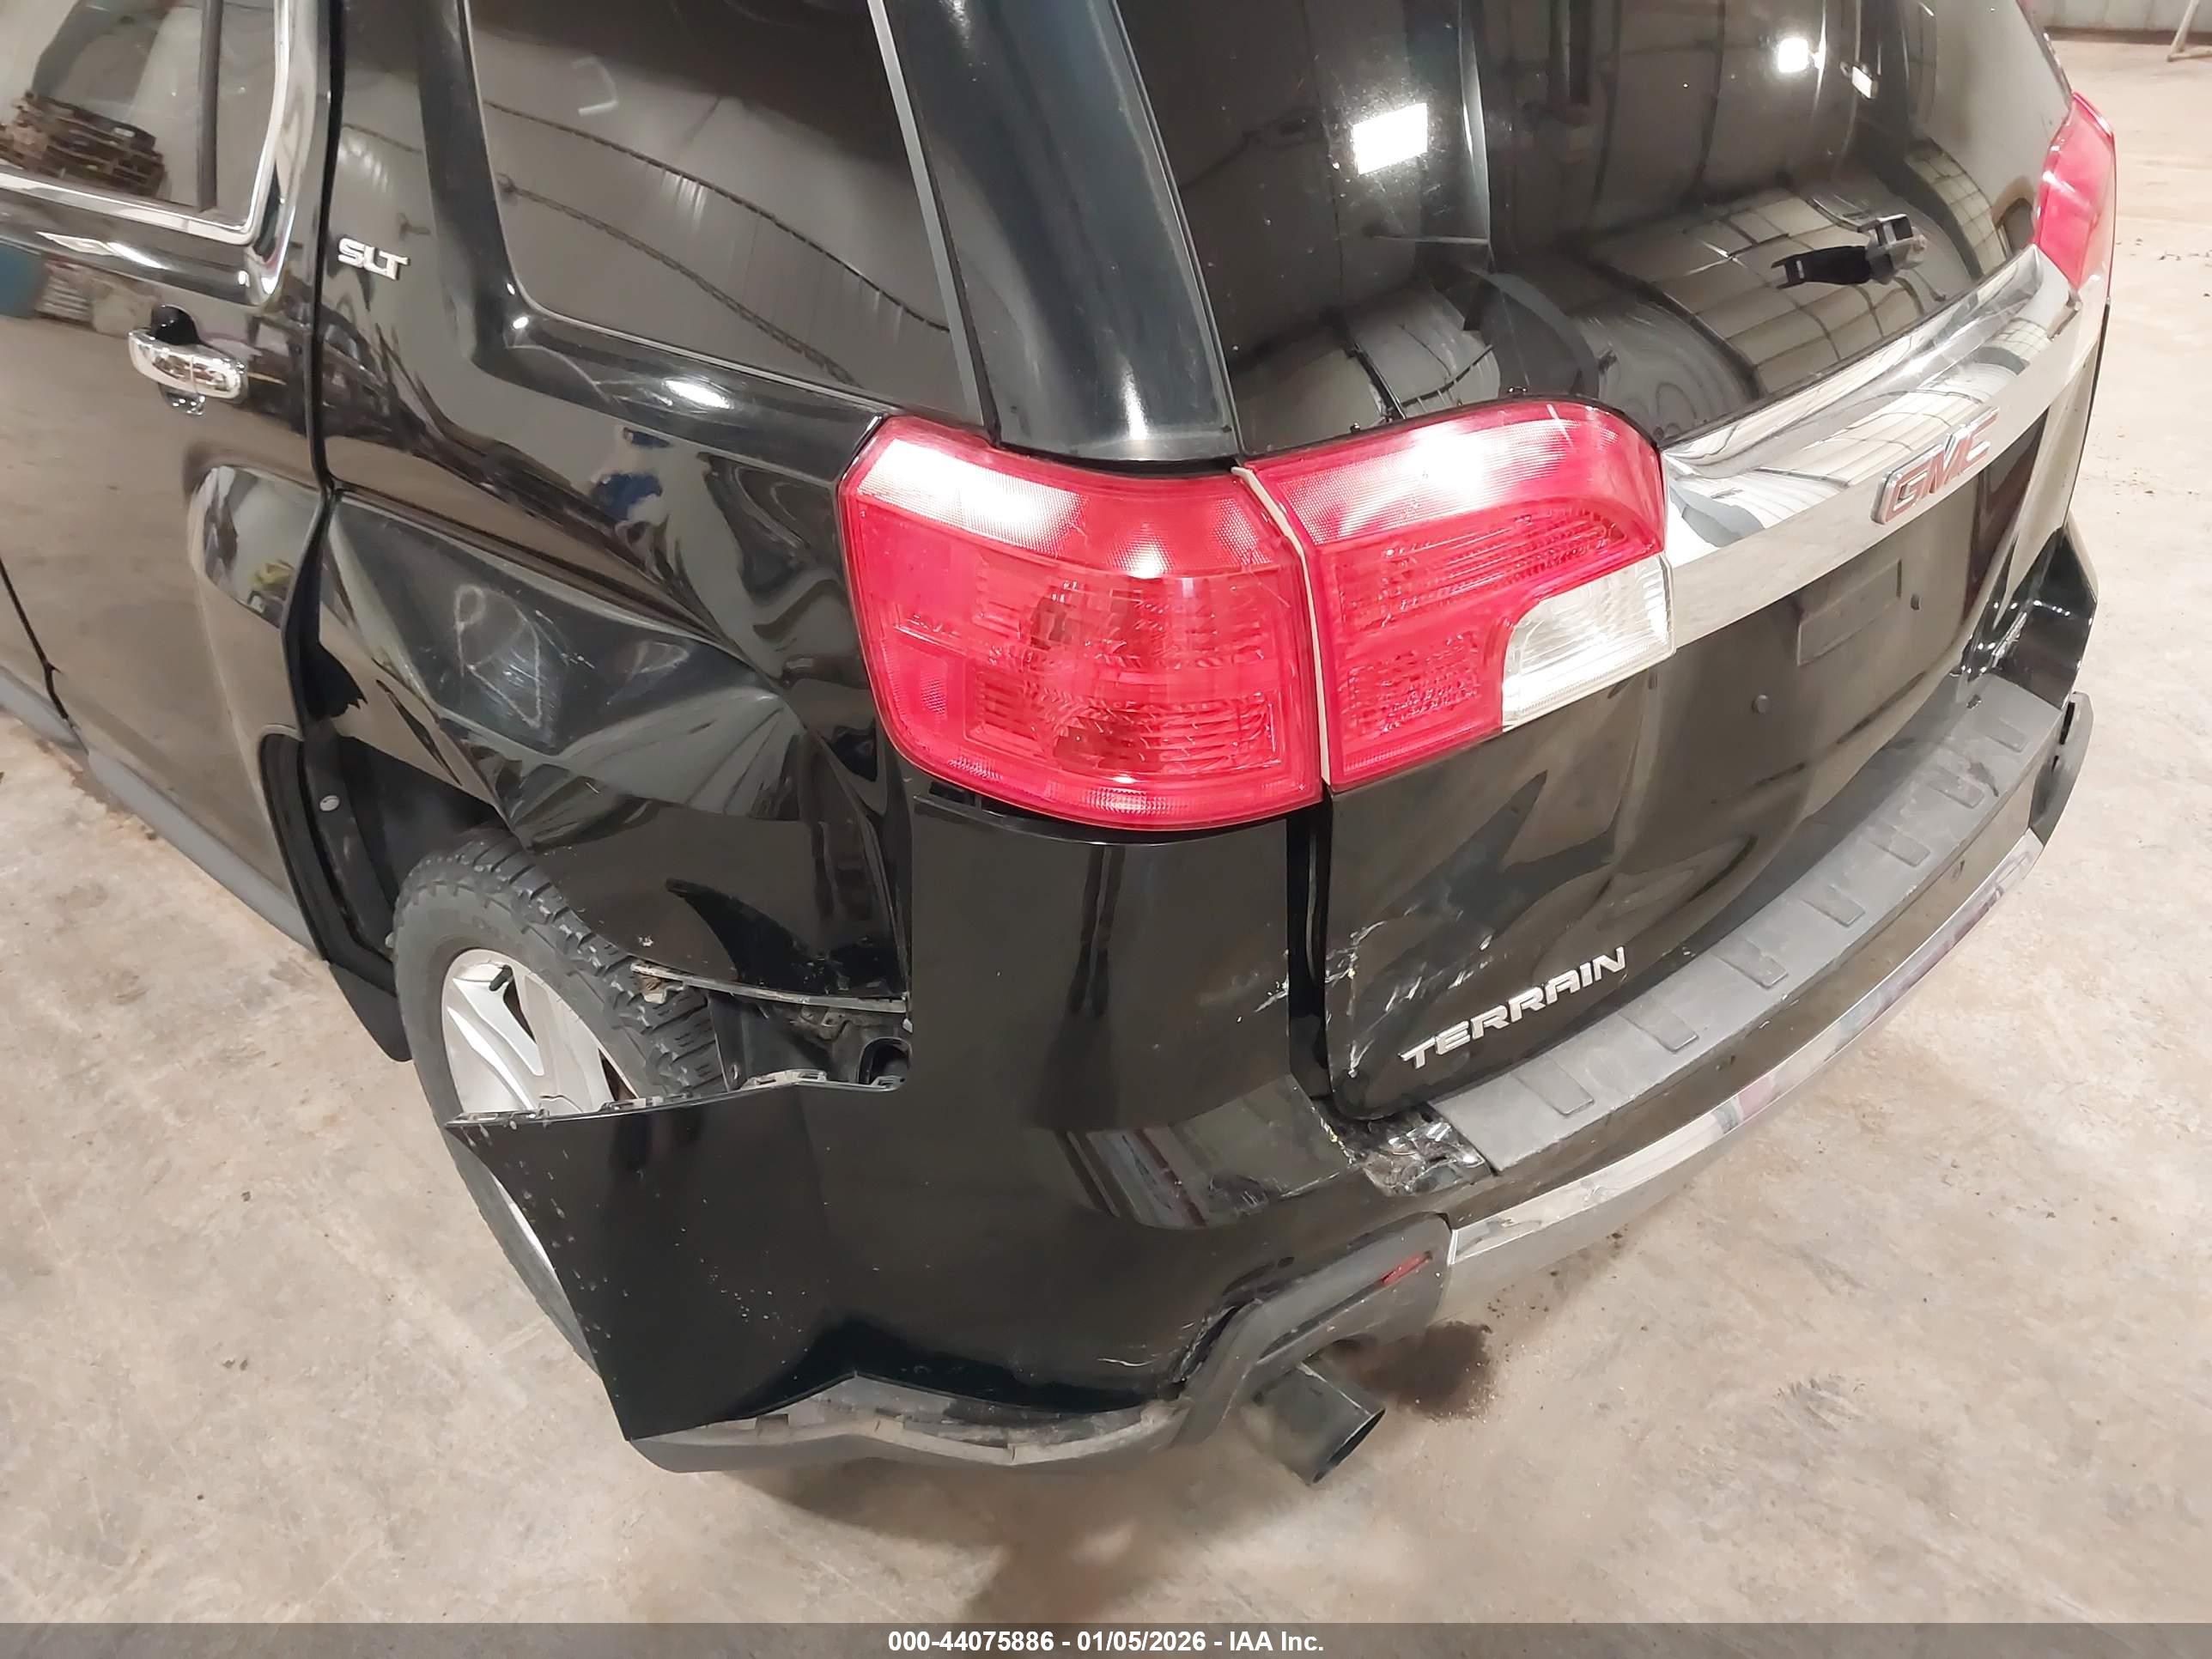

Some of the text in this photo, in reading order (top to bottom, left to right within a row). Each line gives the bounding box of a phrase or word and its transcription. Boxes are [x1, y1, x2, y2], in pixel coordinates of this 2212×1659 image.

[337, 237, 410, 281] SLT
[1872, 407, 1999, 524] GMC
[1399, 945, 1626, 1069] TERRAIN
